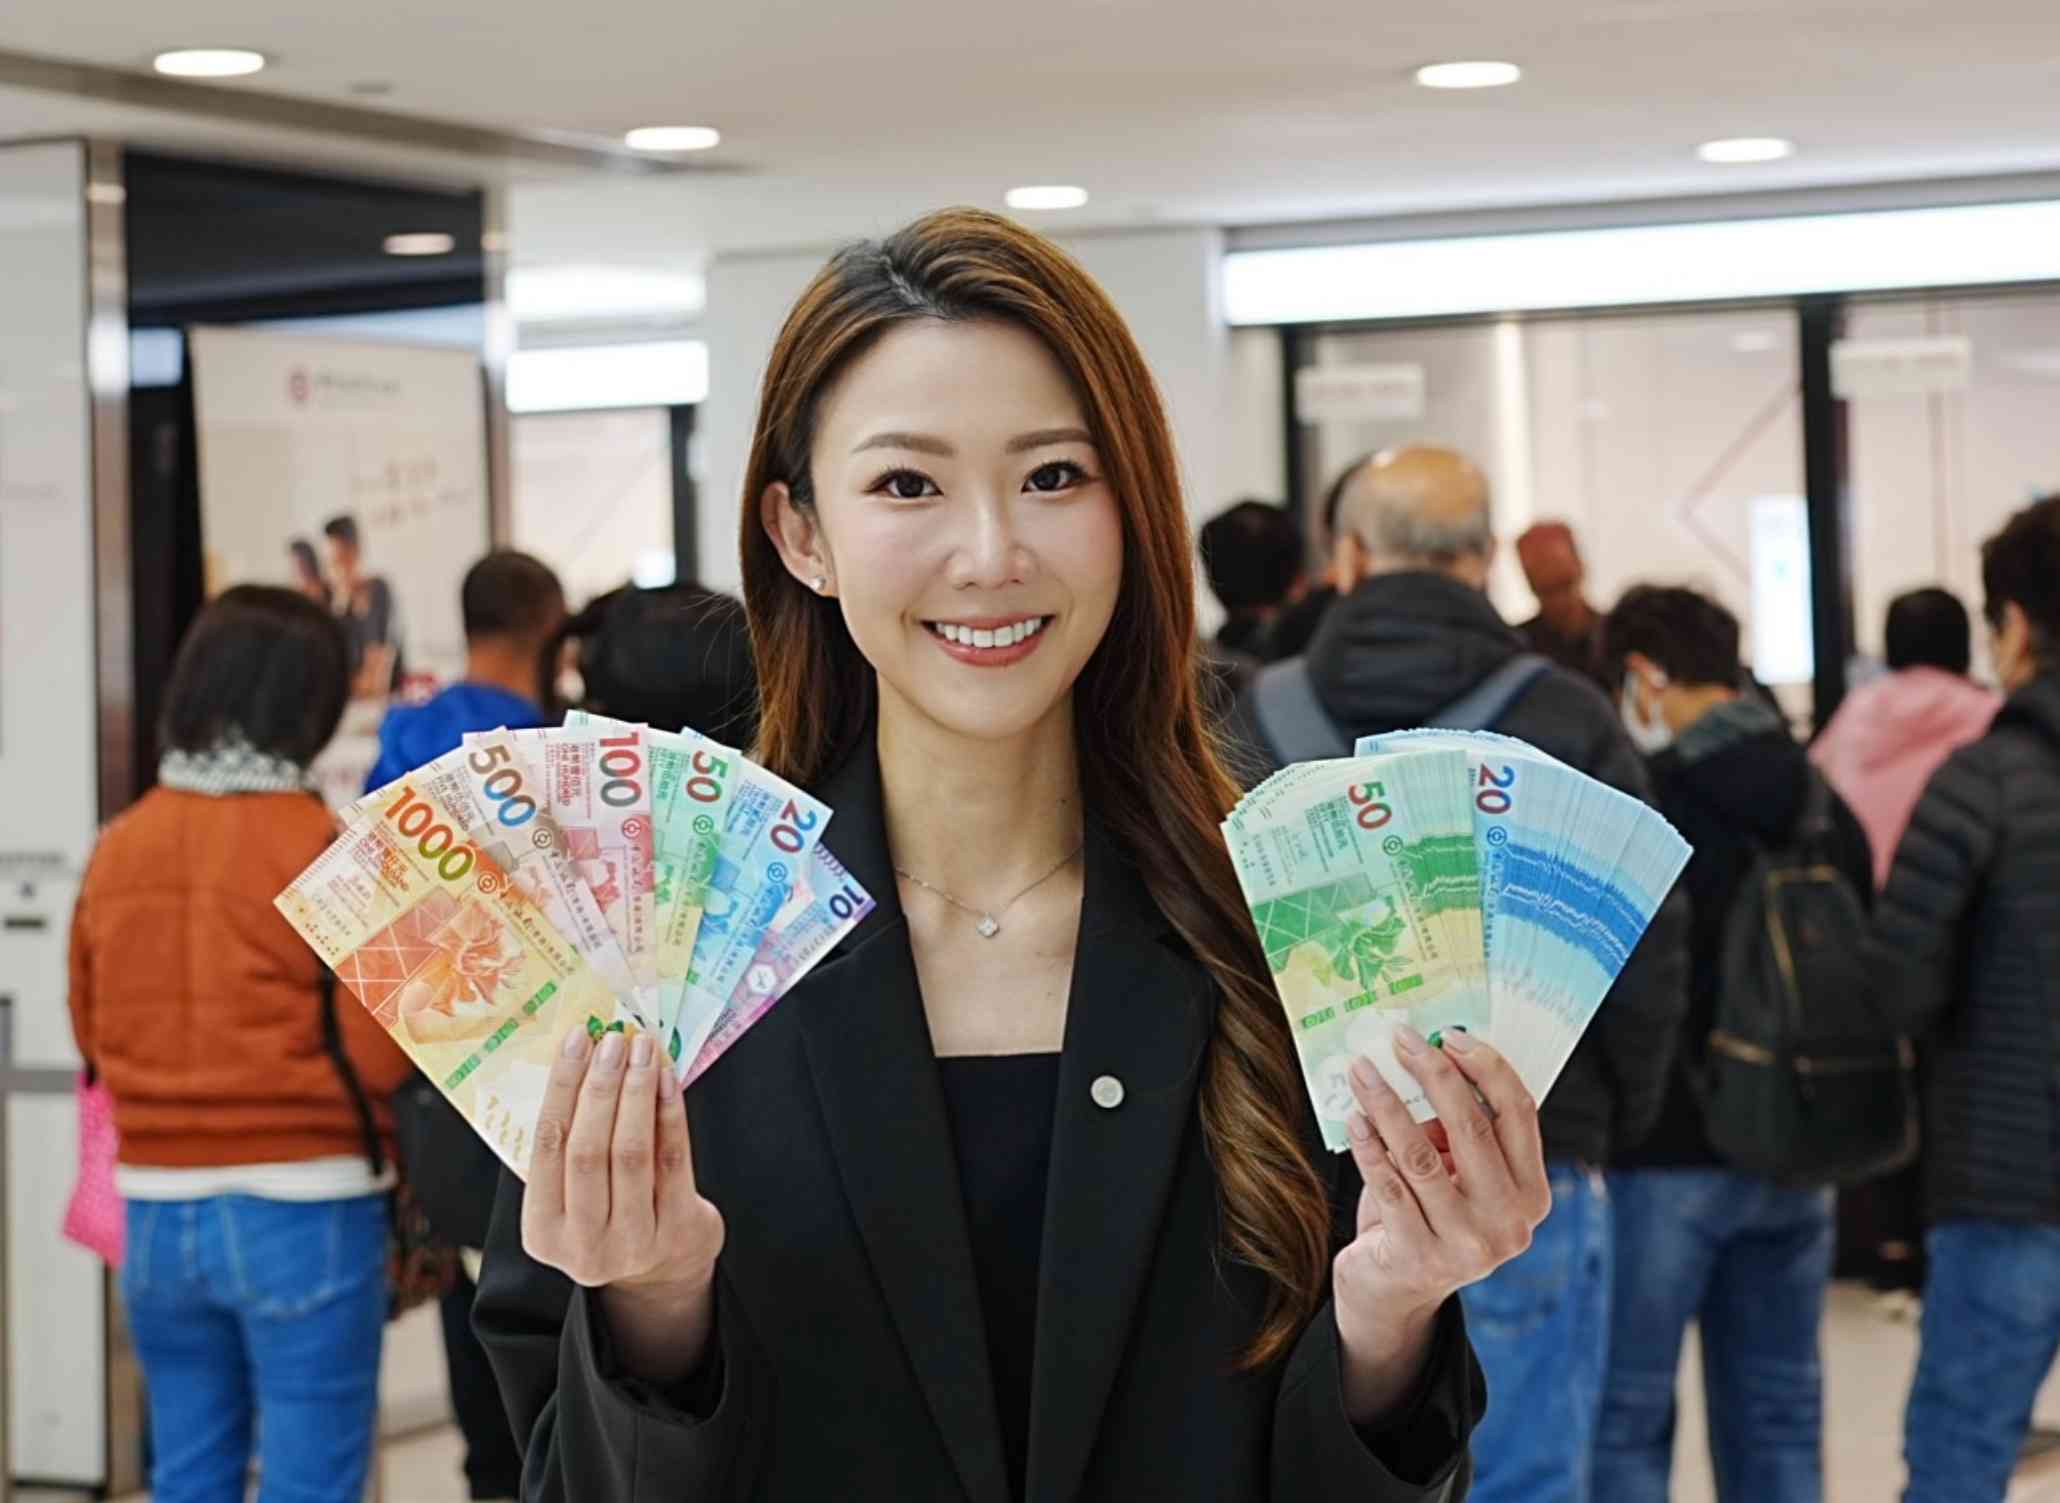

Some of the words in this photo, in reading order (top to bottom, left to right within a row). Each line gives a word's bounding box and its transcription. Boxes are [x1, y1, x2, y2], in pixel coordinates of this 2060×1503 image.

[468, 744, 537, 827] 500
[599, 731, 642, 808] 100
[686, 751, 729, 803] 50
[1475, 763, 1515, 815] 20
[770, 799, 818, 853] 20
[1348, 780, 1393, 829] 50
[384, 785, 476, 882] 1000
[829, 884, 865, 919] 10
